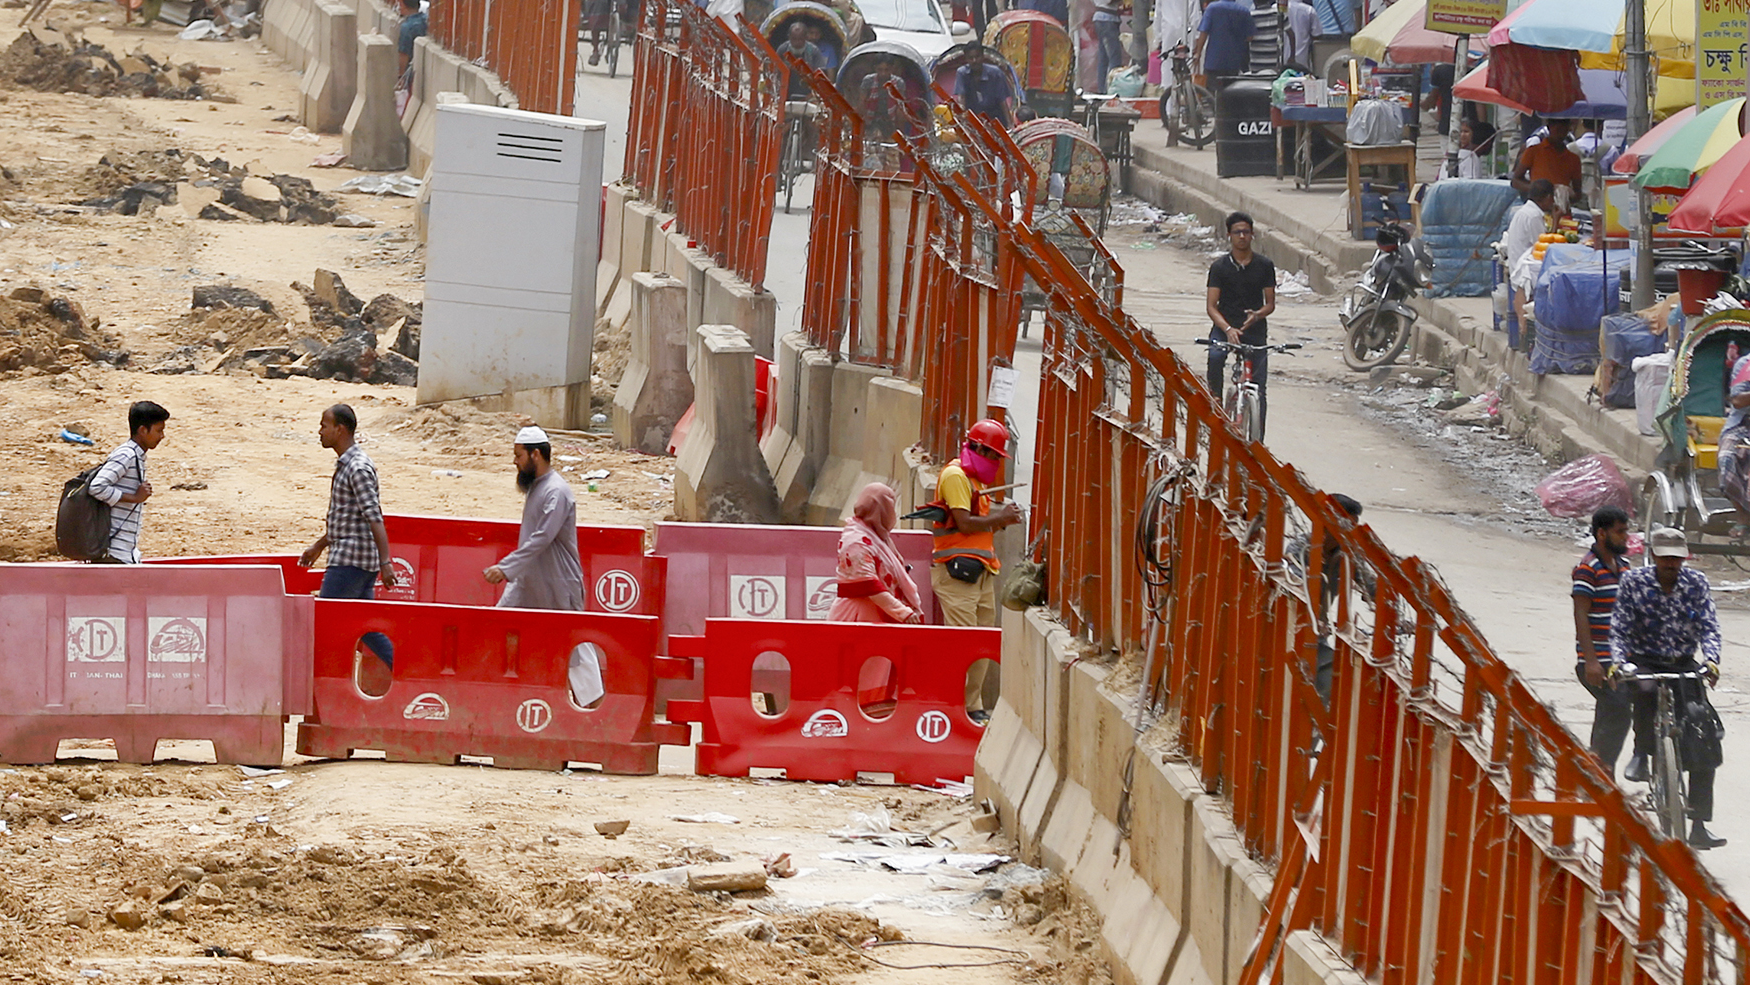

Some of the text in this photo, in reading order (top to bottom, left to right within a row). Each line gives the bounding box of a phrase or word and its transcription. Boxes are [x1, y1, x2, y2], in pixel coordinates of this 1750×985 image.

[1704, 50, 1735, 74] চক্ষু
[1238, 121, 1272, 135] GAZI
[105, 671, 123, 679] THAI
